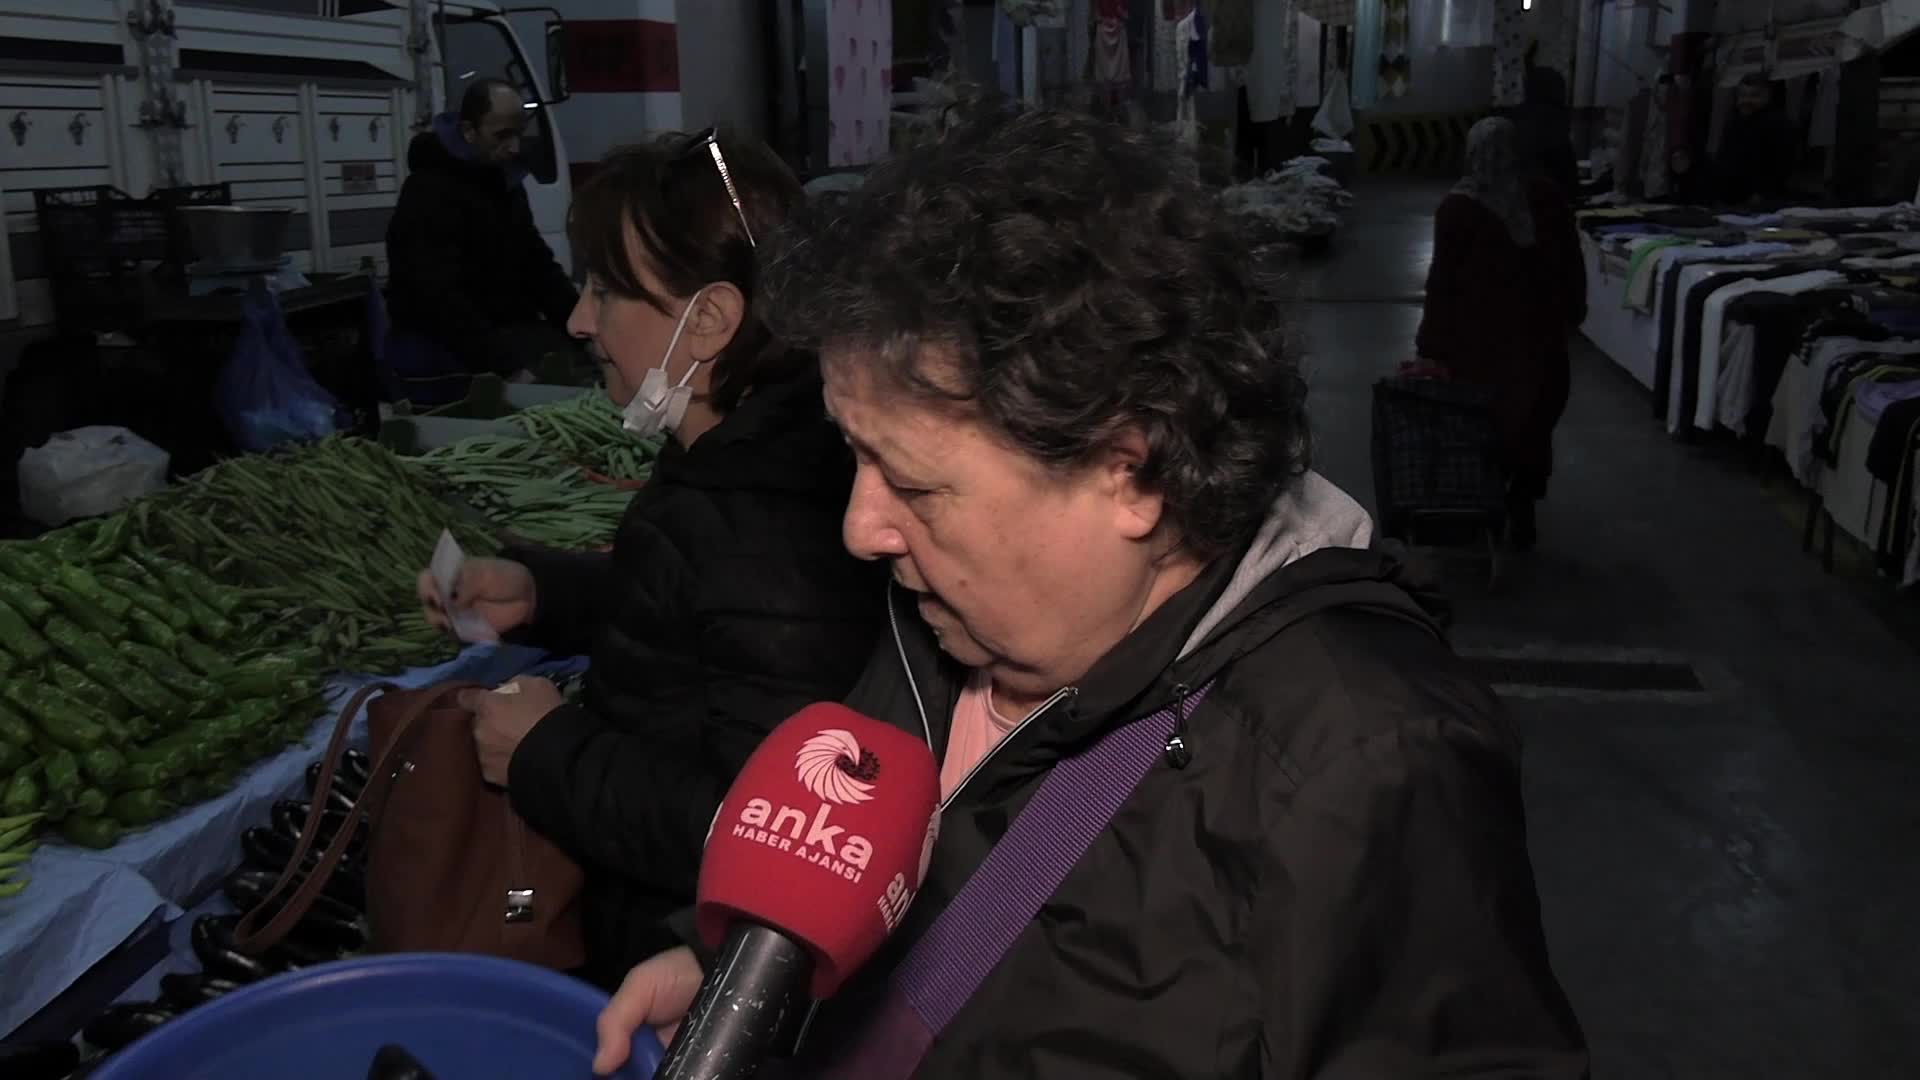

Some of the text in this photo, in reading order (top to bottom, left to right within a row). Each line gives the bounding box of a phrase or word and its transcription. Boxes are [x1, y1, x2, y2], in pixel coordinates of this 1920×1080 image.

[733, 824, 862, 884] HABER AJANSI
[740, 798, 873, 870] anka
